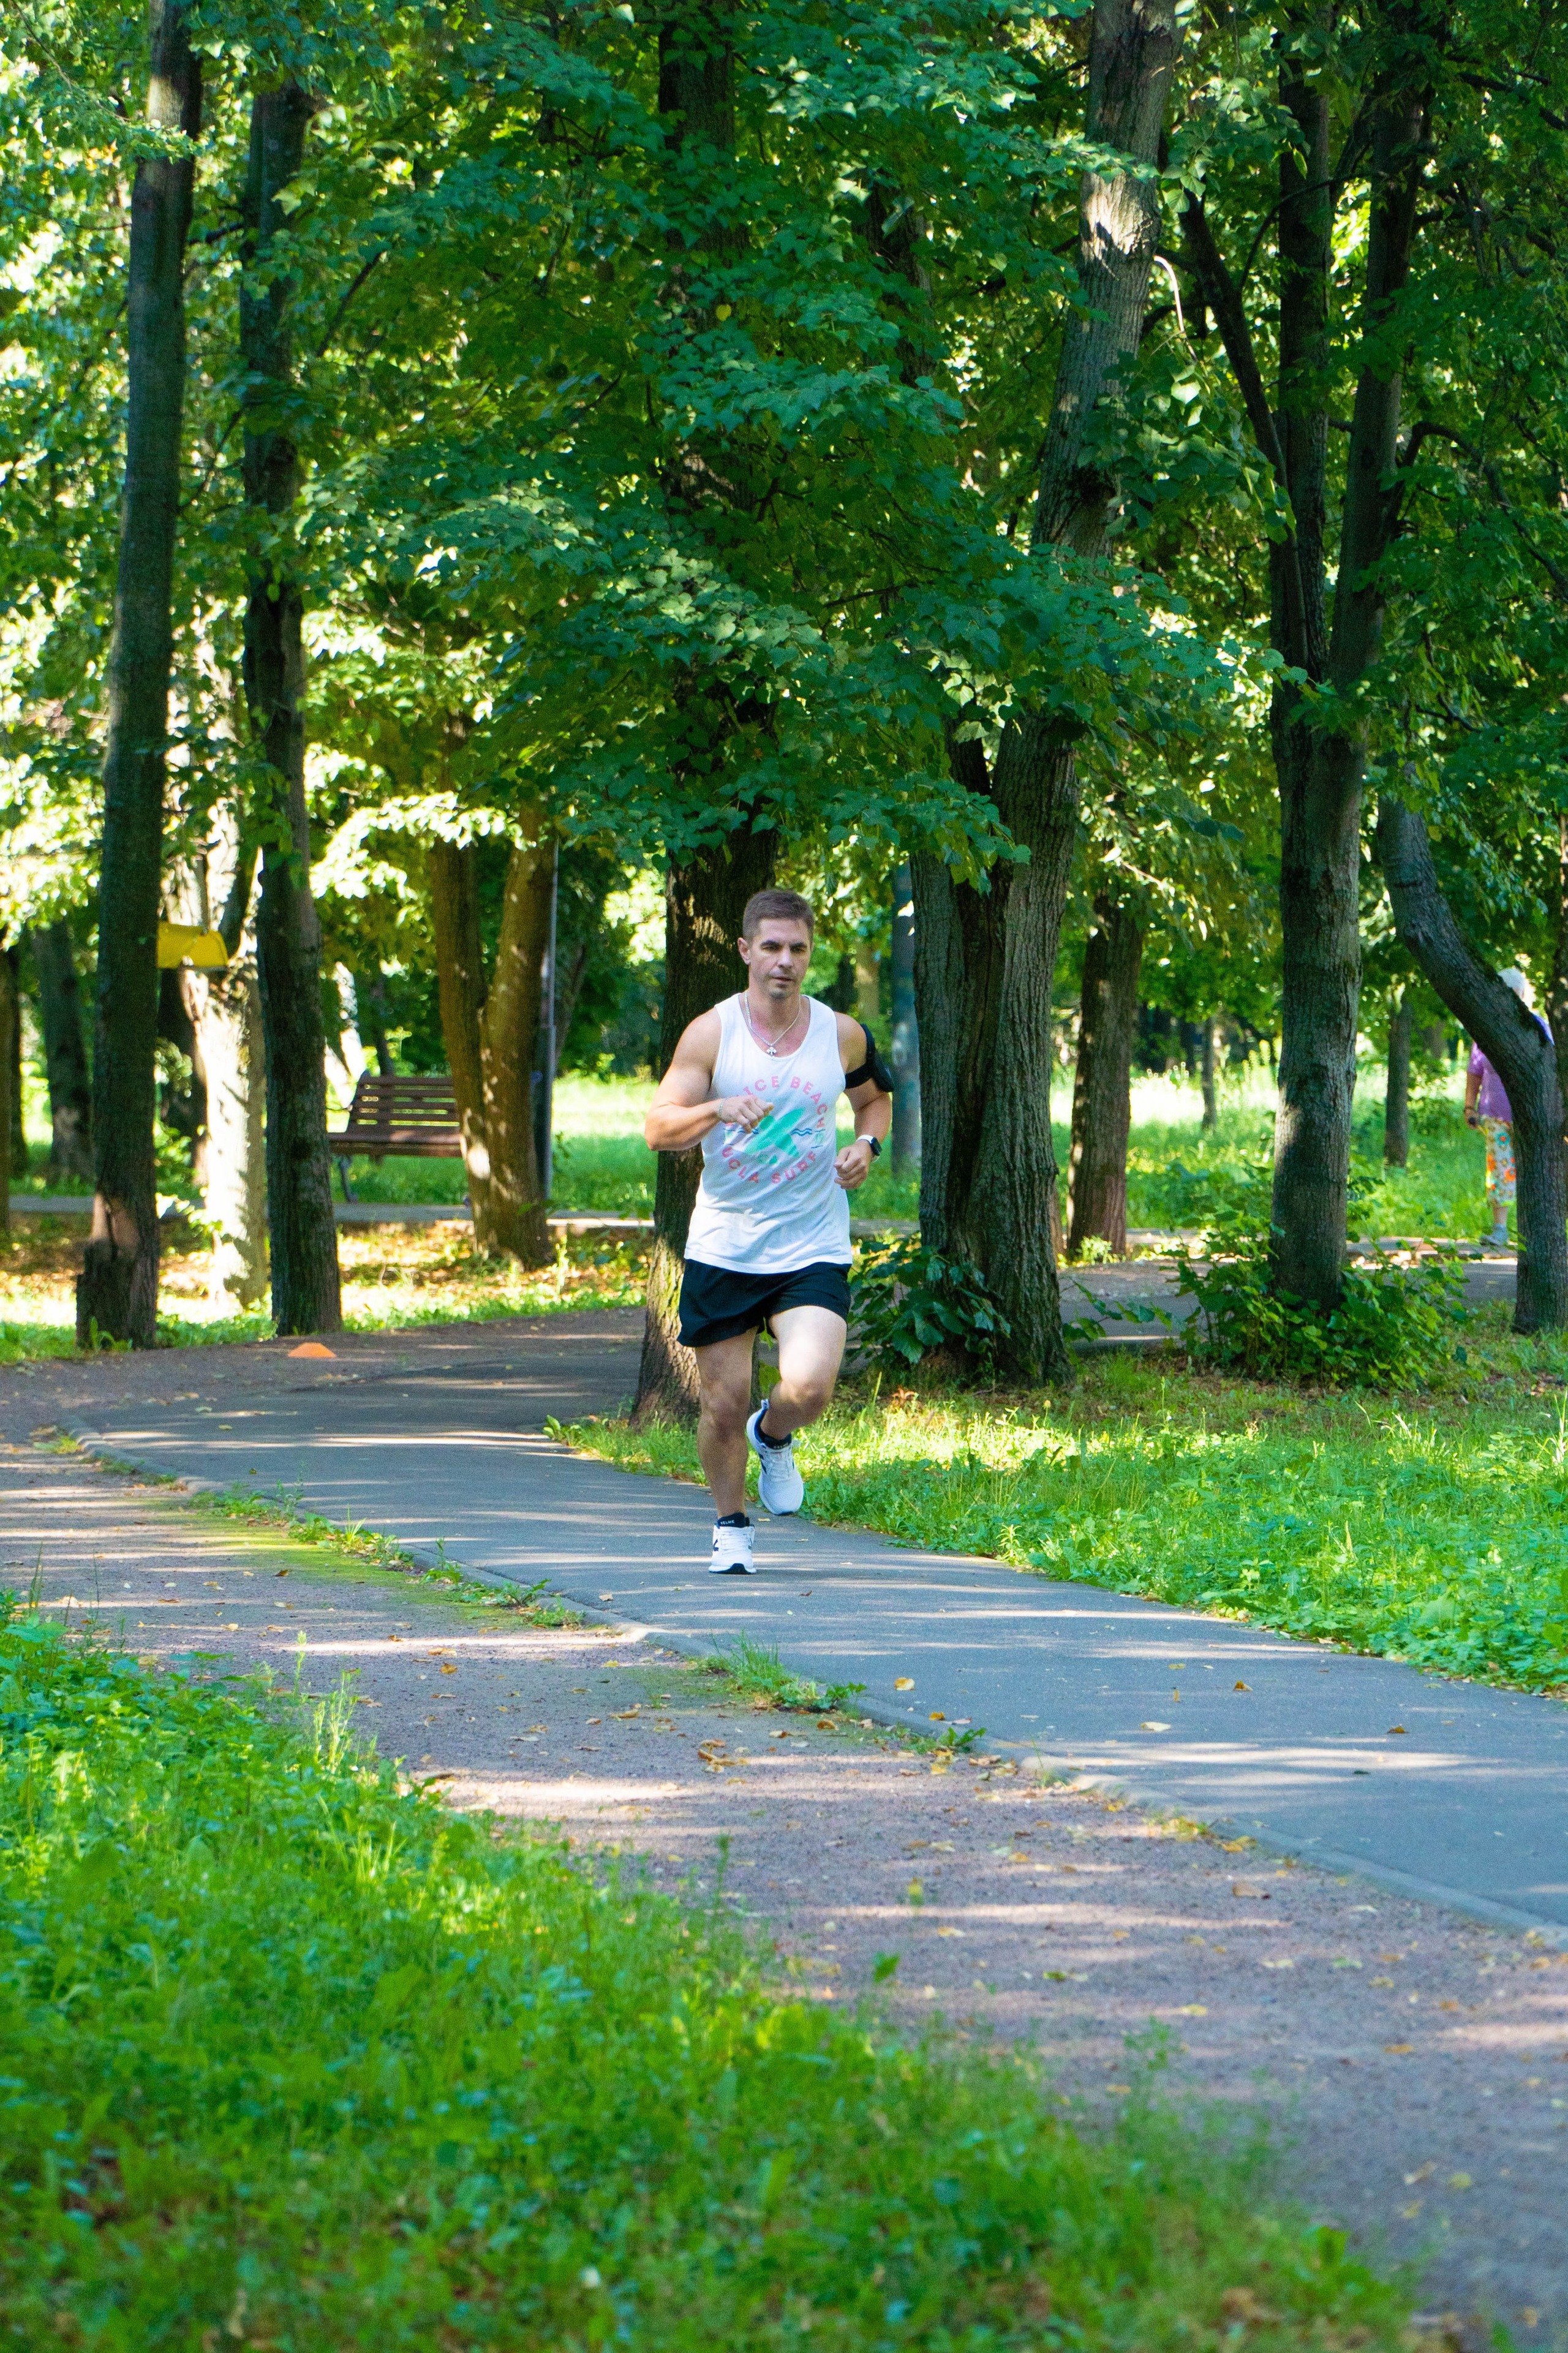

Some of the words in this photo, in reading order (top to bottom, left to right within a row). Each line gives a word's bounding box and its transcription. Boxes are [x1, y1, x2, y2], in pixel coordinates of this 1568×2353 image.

[790, 1076, 828, 1128] BEACH
[722, 1146, 759, 1184] UCLA
[771, 1151, 816, 1184] SURF
